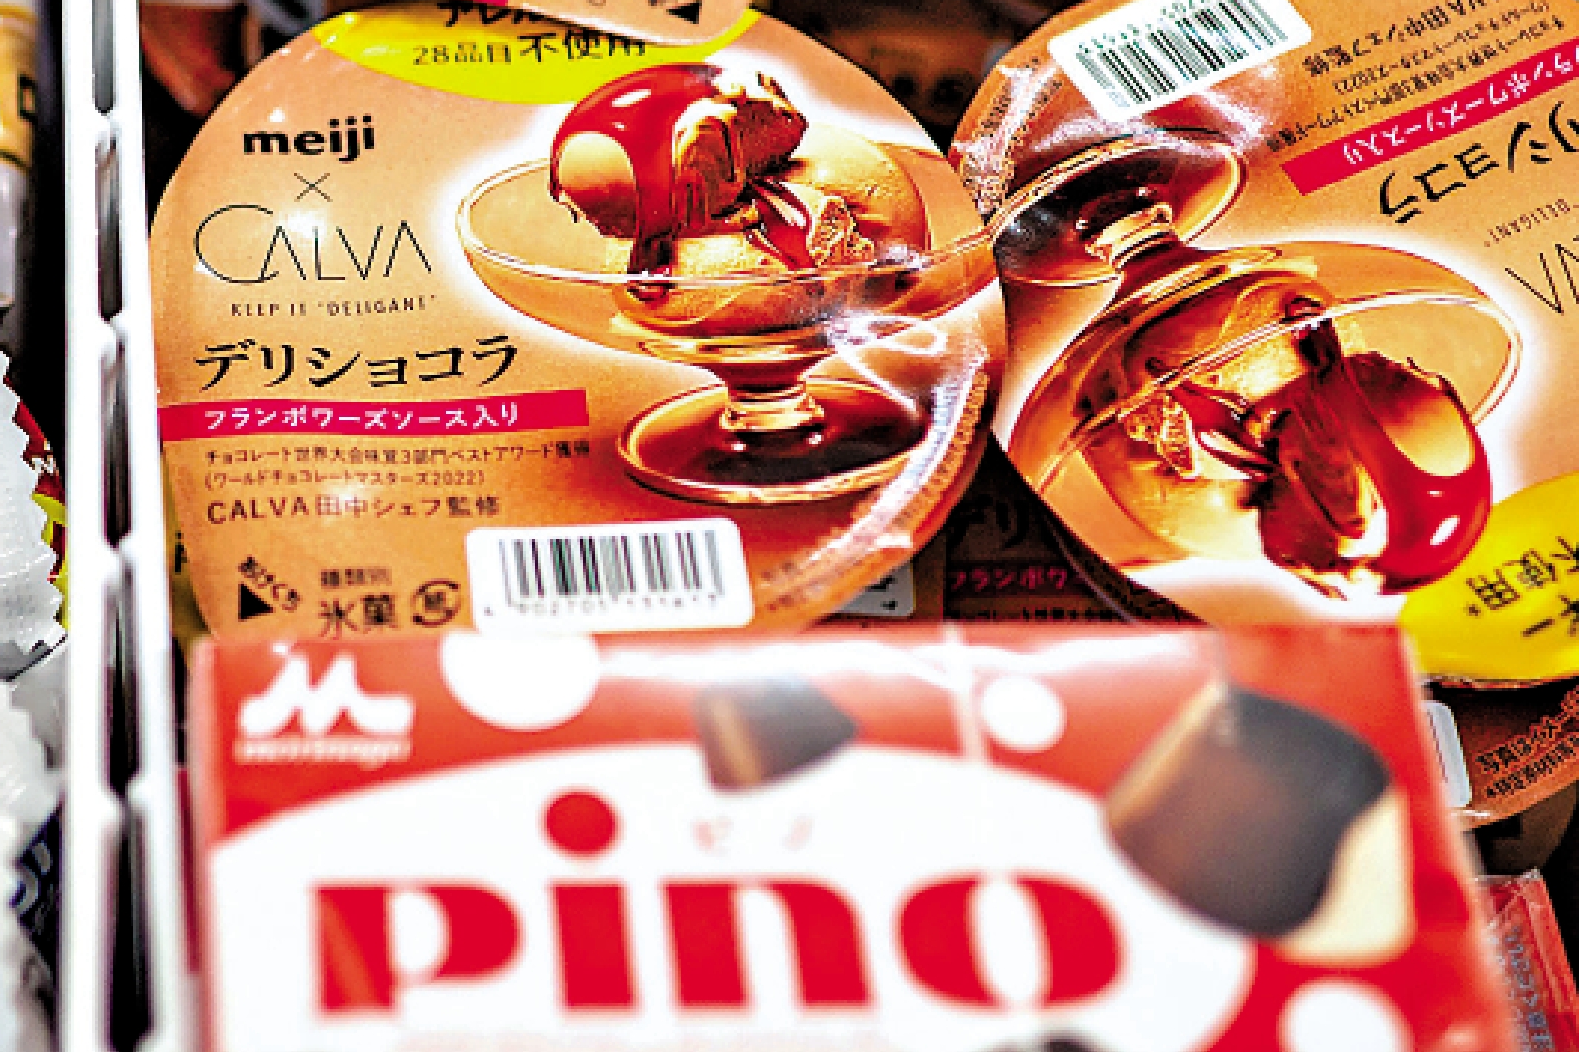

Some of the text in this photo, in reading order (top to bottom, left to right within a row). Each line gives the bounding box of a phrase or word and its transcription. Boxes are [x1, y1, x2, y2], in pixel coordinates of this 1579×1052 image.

[243, 114, 377, 162] meiji
[194, 204, 433, 284] CALVA
[194, 334, 520, 393] デリショコラ
[204, 401, 519, 432] フランボワーズソース入り
[311, 790, 1127, 1016] pino
